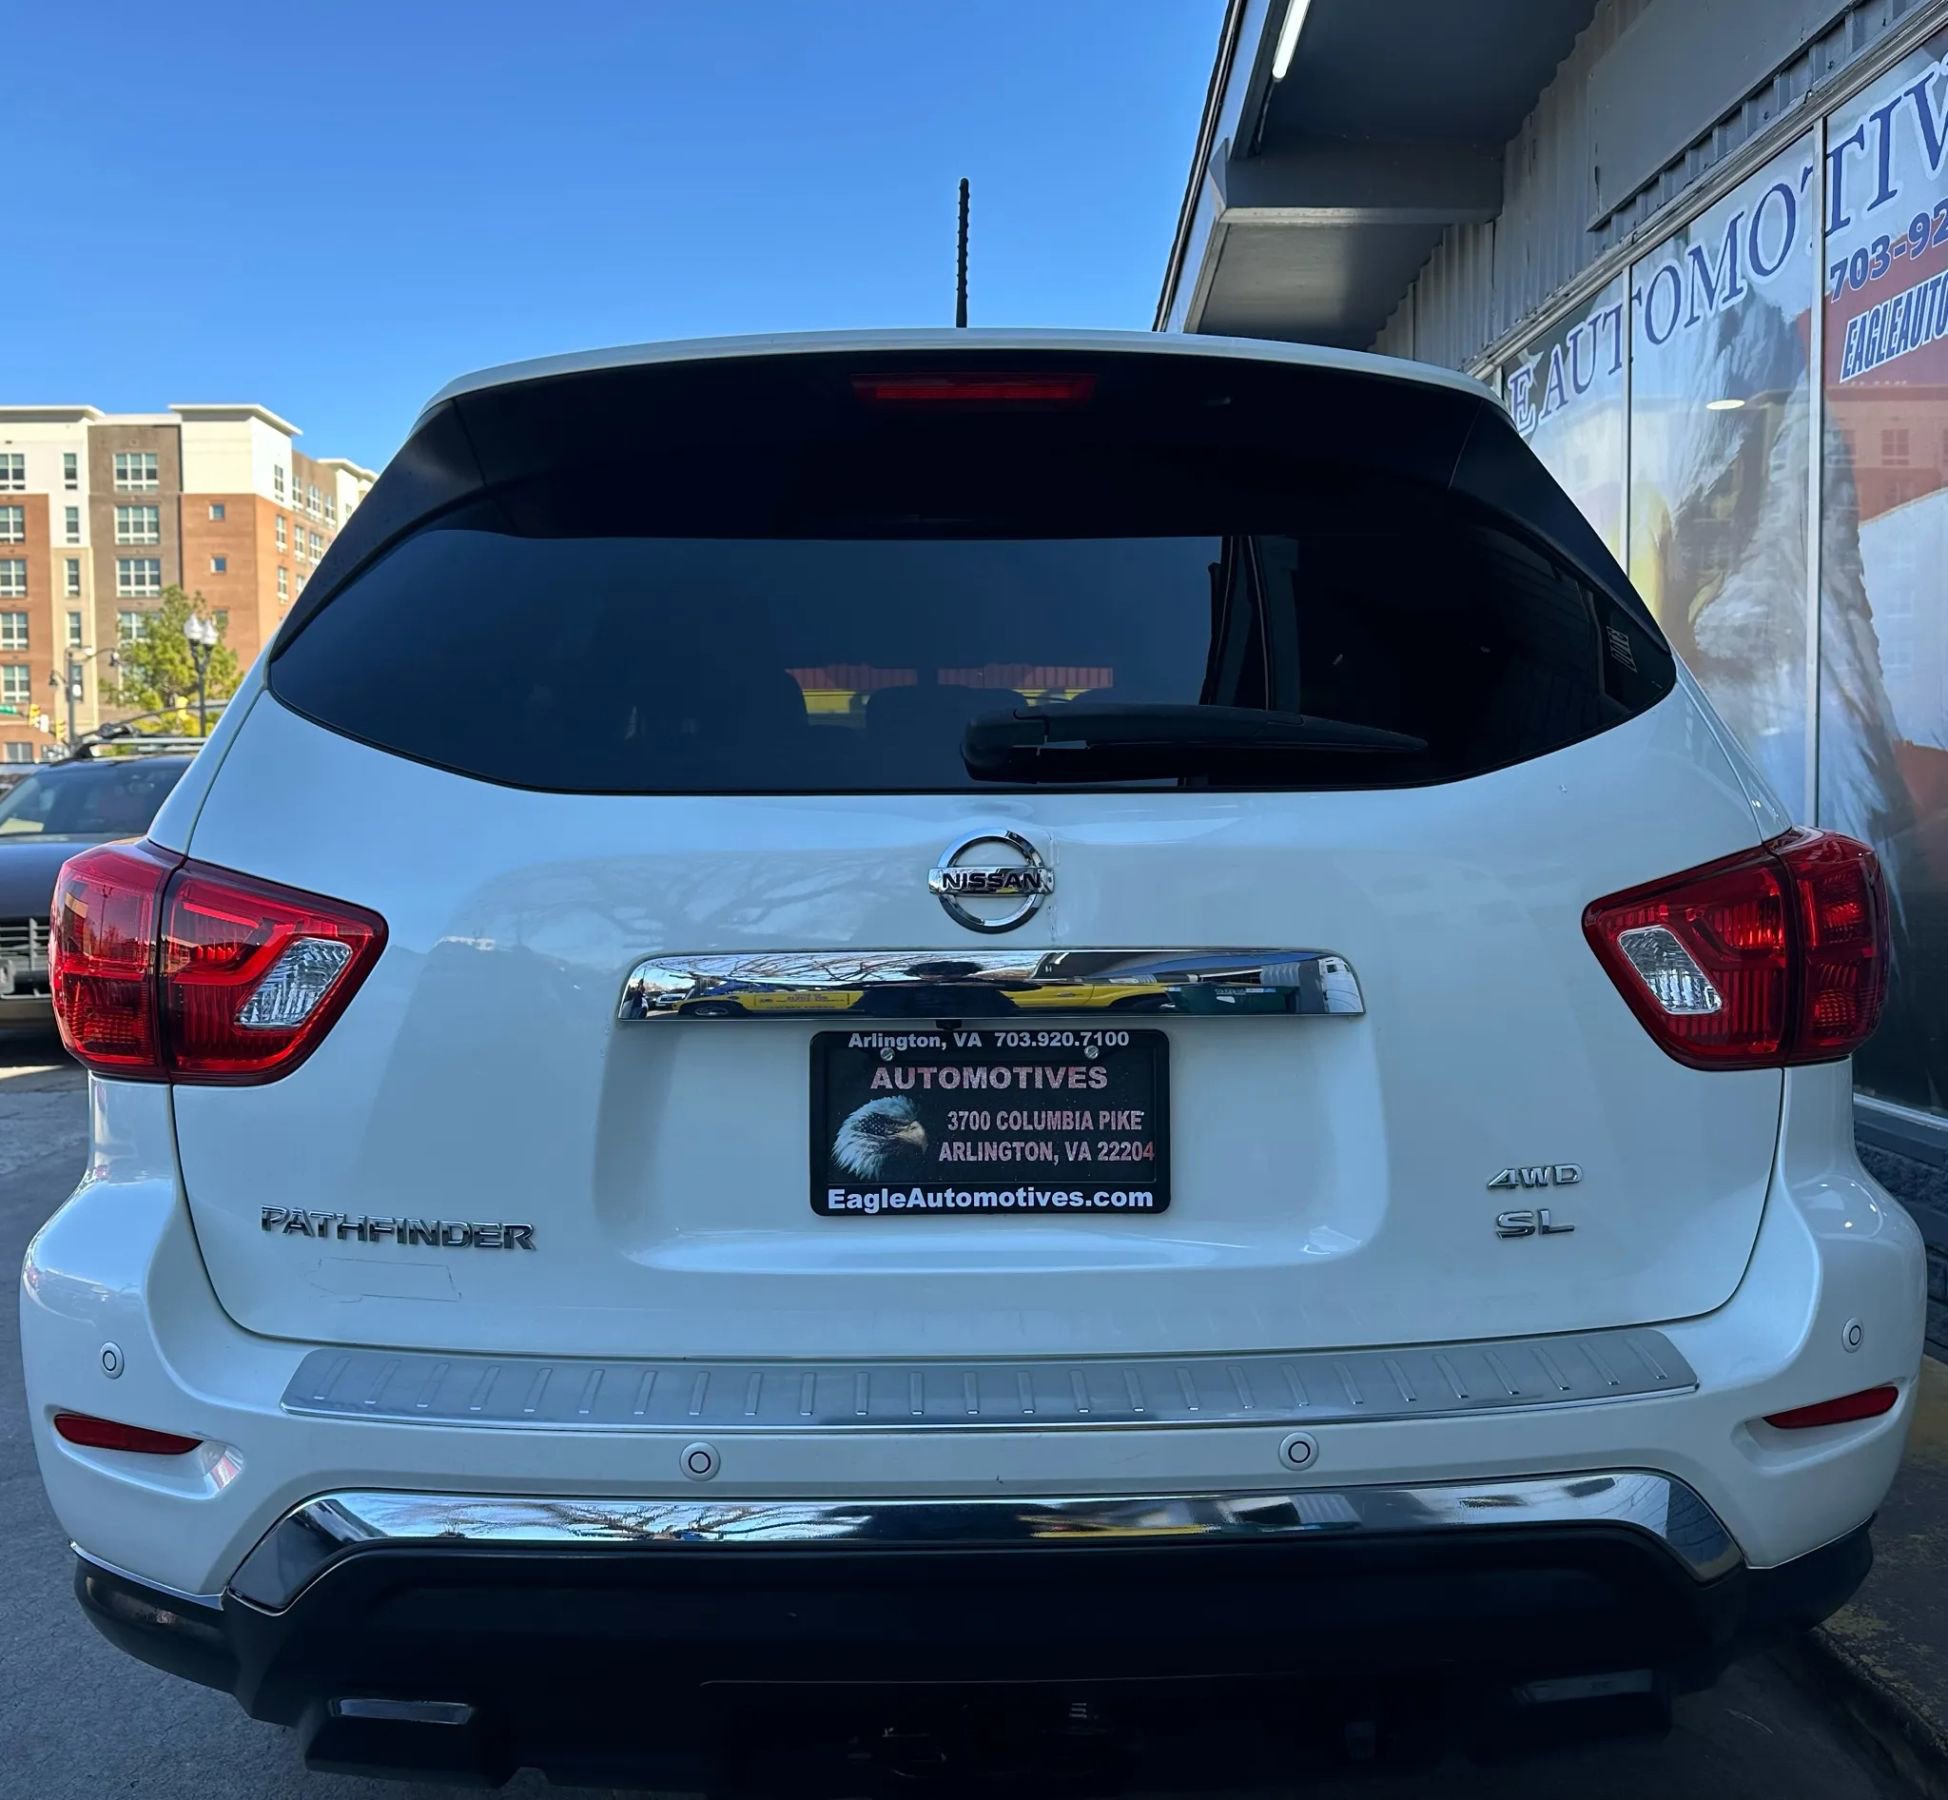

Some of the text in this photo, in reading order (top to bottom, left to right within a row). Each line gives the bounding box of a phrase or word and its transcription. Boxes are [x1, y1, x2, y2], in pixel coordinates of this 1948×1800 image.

[942, 872, 1041, 889] NISSAN
[848, 1031, 1130, 1051] Arlington, VA 703.920.7100
[870, 1066, 1108, 1090] AUTOMOTIVES
[947, 1111, 1143, 1131] 3700 COLUMBIA PIKE
[938, 1140, 1155, 1166] ARLINGTON, VA 22204
[1487, 1163, 1583, 1190] 4WD
[828, 1187, 1153, 1214] EagleAutomotives.com
[261, 1204, 537, 1251] PATHFINDER
[1496, 1208, 1575, 1239] SL
